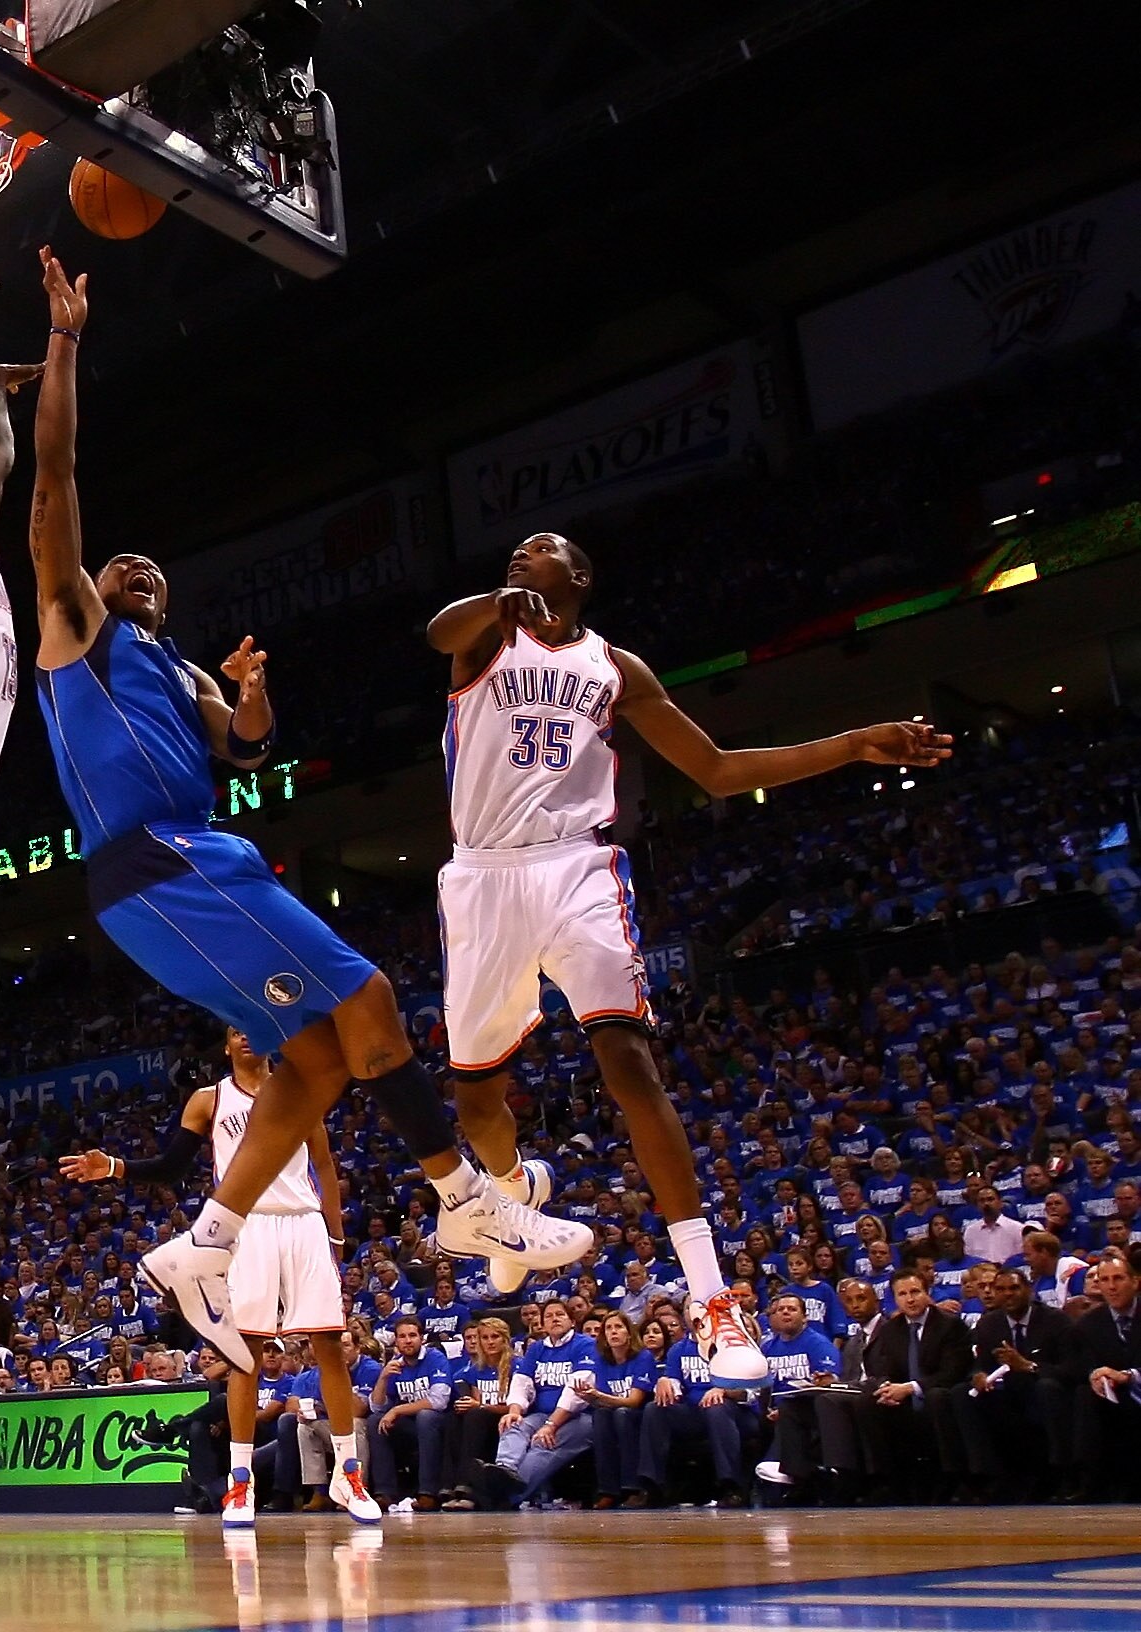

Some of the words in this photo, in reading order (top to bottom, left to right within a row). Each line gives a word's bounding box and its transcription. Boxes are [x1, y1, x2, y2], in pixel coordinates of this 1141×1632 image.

[512, 393, 731, 513] PLAYOFFS
[196, 542, 406, 642] THUNDER
[489, 667, 612, 726] THUNDER
[509, 715, 574, 771] 35
[645, 947, 686, 974] 115
[70, 1069, 119, 1107] TO
[136, 1050, 165, 1074] 114
[9, 1414, 86, 1470] NBA
